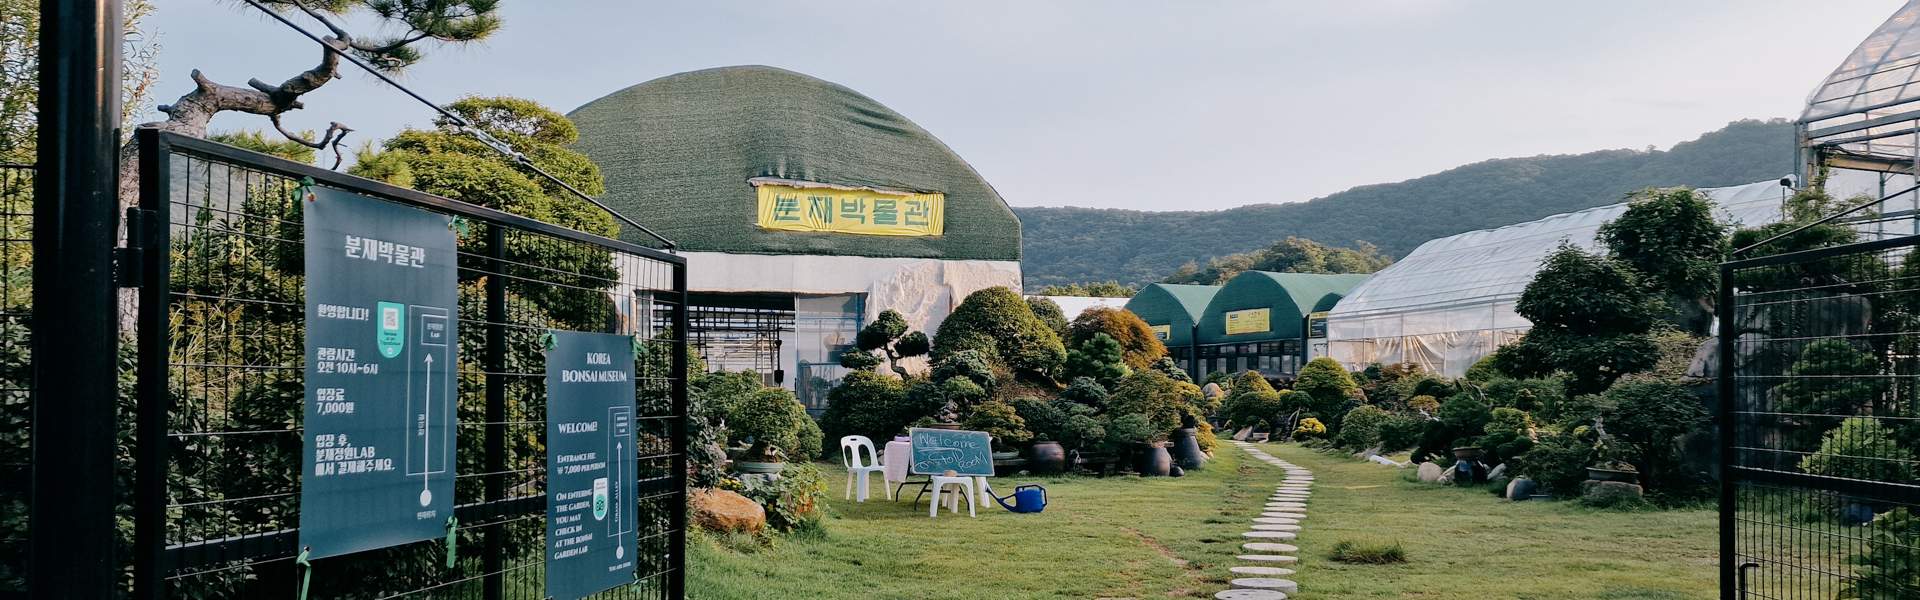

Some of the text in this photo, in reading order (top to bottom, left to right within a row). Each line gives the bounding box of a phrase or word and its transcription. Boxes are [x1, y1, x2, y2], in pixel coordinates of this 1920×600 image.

[775, 194, 929, 226] 분재박물관
[344, 234, 426, 269] 분재박물관
[317, 303, 370, 321] 환영합니다!
[317, 347, 356, 362] 관람시간
[586, 352, 612, 365] KOREA
[317, 362, 379, 375] 오전 10시~6시
[562, 369, 628, 383] BONSAI MUSEUM
[316, 388, 346, 402] 입장료
[316, 402, 356, 416] 7,000원
[558, 421, 599, 434] WELCOME!
[315, 433, 352, 448] 입장 후,
[315, 446, 376, 463] 분재정원LAB
[314, 462, 336, 476] 에서
[564, 464, 581, 475] 7,000
[556, 491, 567, 502] ON
[556, 504, 568, 513] THE
[555, 513, 582, 525] YOU MAY
[555, 525, 577, 537] CHECK
[555, 539, 564, 549] AT
[563, 537, 576, 546] THE
[554, 548, 579, 560] GARDEN
